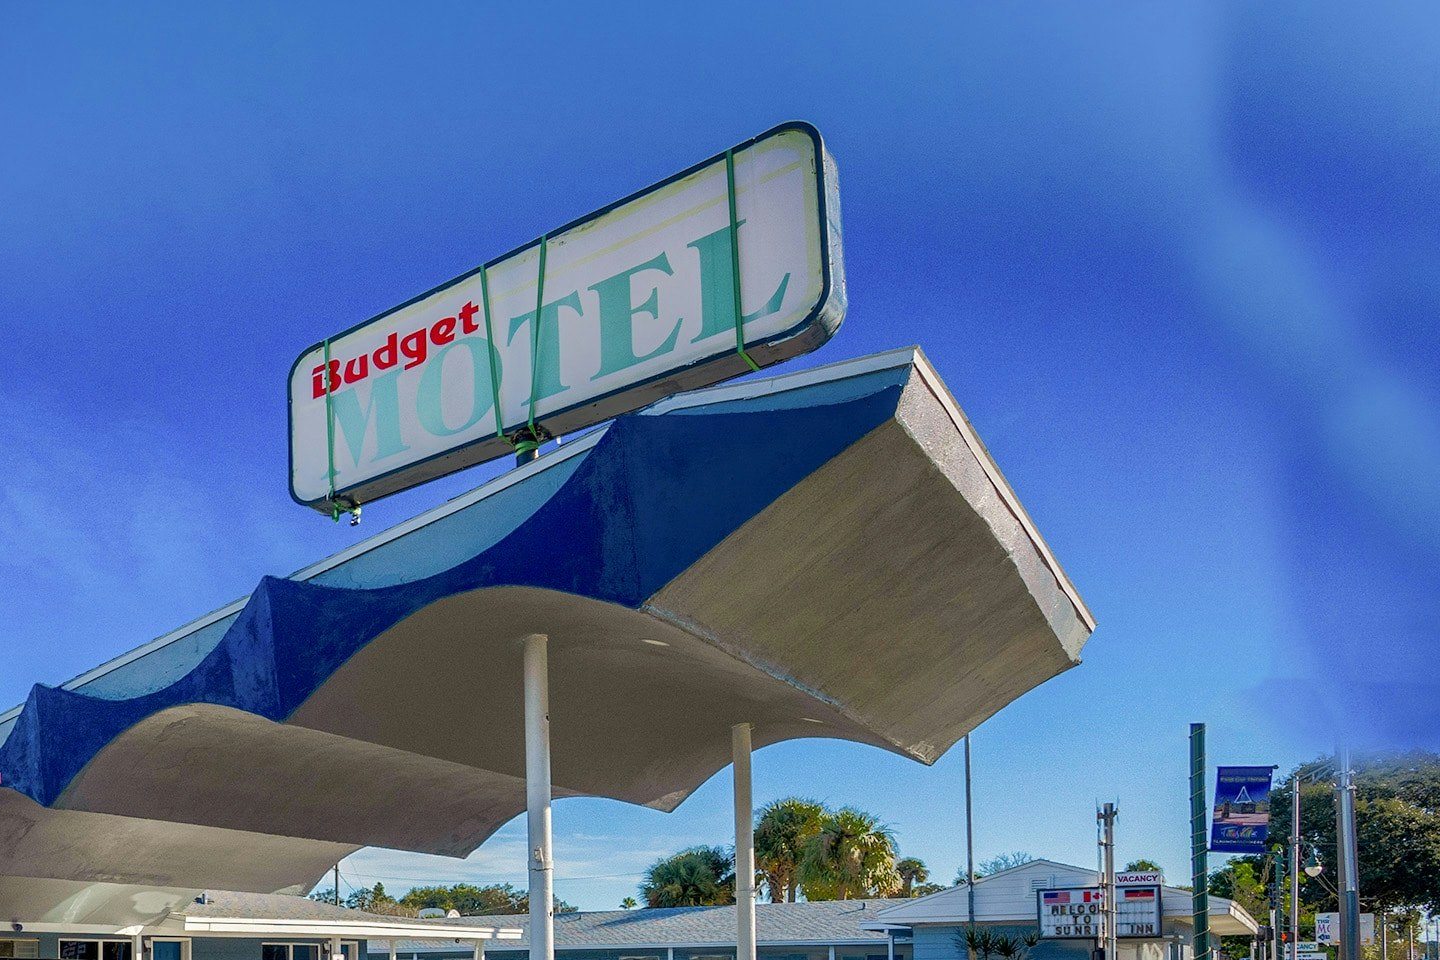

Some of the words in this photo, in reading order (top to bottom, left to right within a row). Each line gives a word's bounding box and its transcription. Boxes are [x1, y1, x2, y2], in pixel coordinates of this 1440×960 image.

[312, 301, 479, 399] Budget
[322, 218, 790, 480] MOTEL
[1117, 874, 1159, 883] VACANCY
[1051, 904, 1105, 916] WELCO
[1072, 915, 1091, 925] TO
[1055, 926, 1106, 935] SUNRI
[1130, 924, 1153, 934] INN
